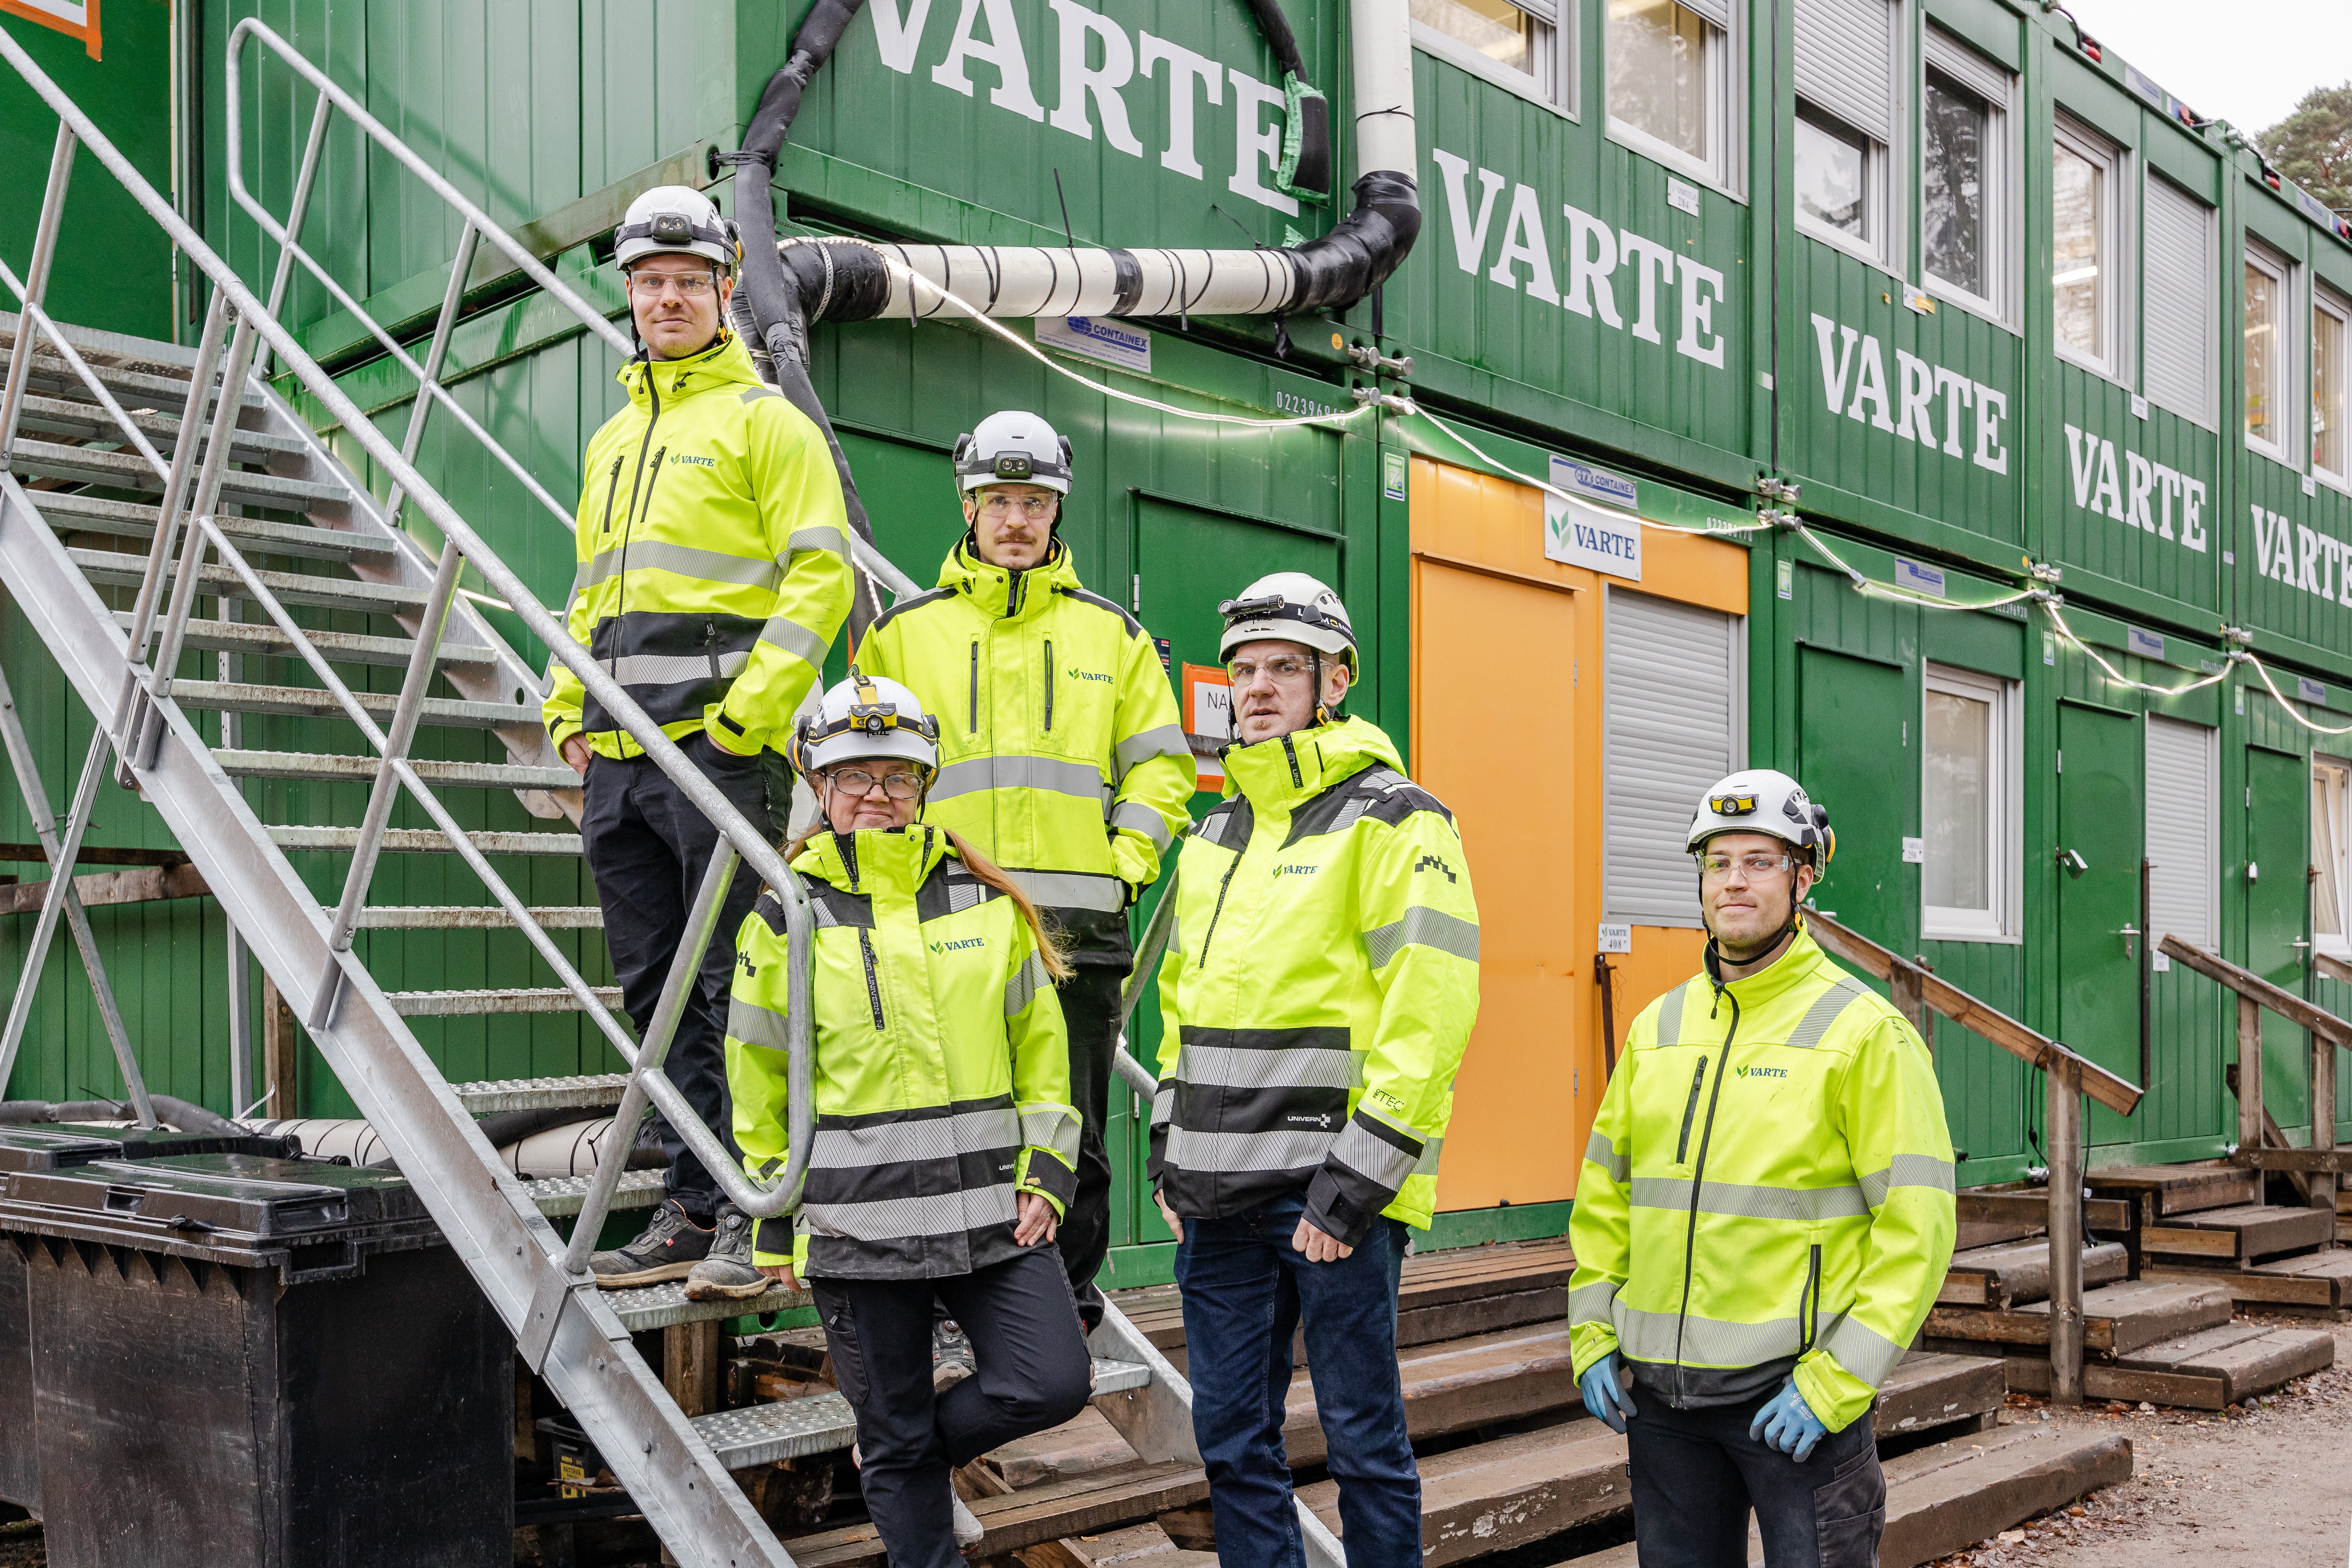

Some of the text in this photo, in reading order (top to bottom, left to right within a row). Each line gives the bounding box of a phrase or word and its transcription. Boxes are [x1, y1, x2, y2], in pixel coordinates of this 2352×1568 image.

[1433, 148, 1724, 369] VARTE
[1093, 325, 1147, 348] CONTAINEX
[1811, 312, 2007, 475] VARTE
[681, 456, 714, 467] VARTE
[1595, 476, 1634, 494] CONTAINEX
[2064, 423, 2206, 553] VARTE
[1574, 523, 1636, 560] VARTE
[2251, 504, 2352, 608] VARTE
[1080, 672, 1113, 684] VARTE
[1283, 865, 1318, 875] VARTE
[944, 938, 984, 951] VARTE
[1608, 939, 1621, 949] 408
[862, 944, 872, 971] UNIVE
[868, 976, 880, 1015] UNIVERN
[1750, 1068, 1787, 1078] VARTE
[1380, 1090, 1404, 1112] TEC
[1797, 1409, 1810, 1420] Aqua
